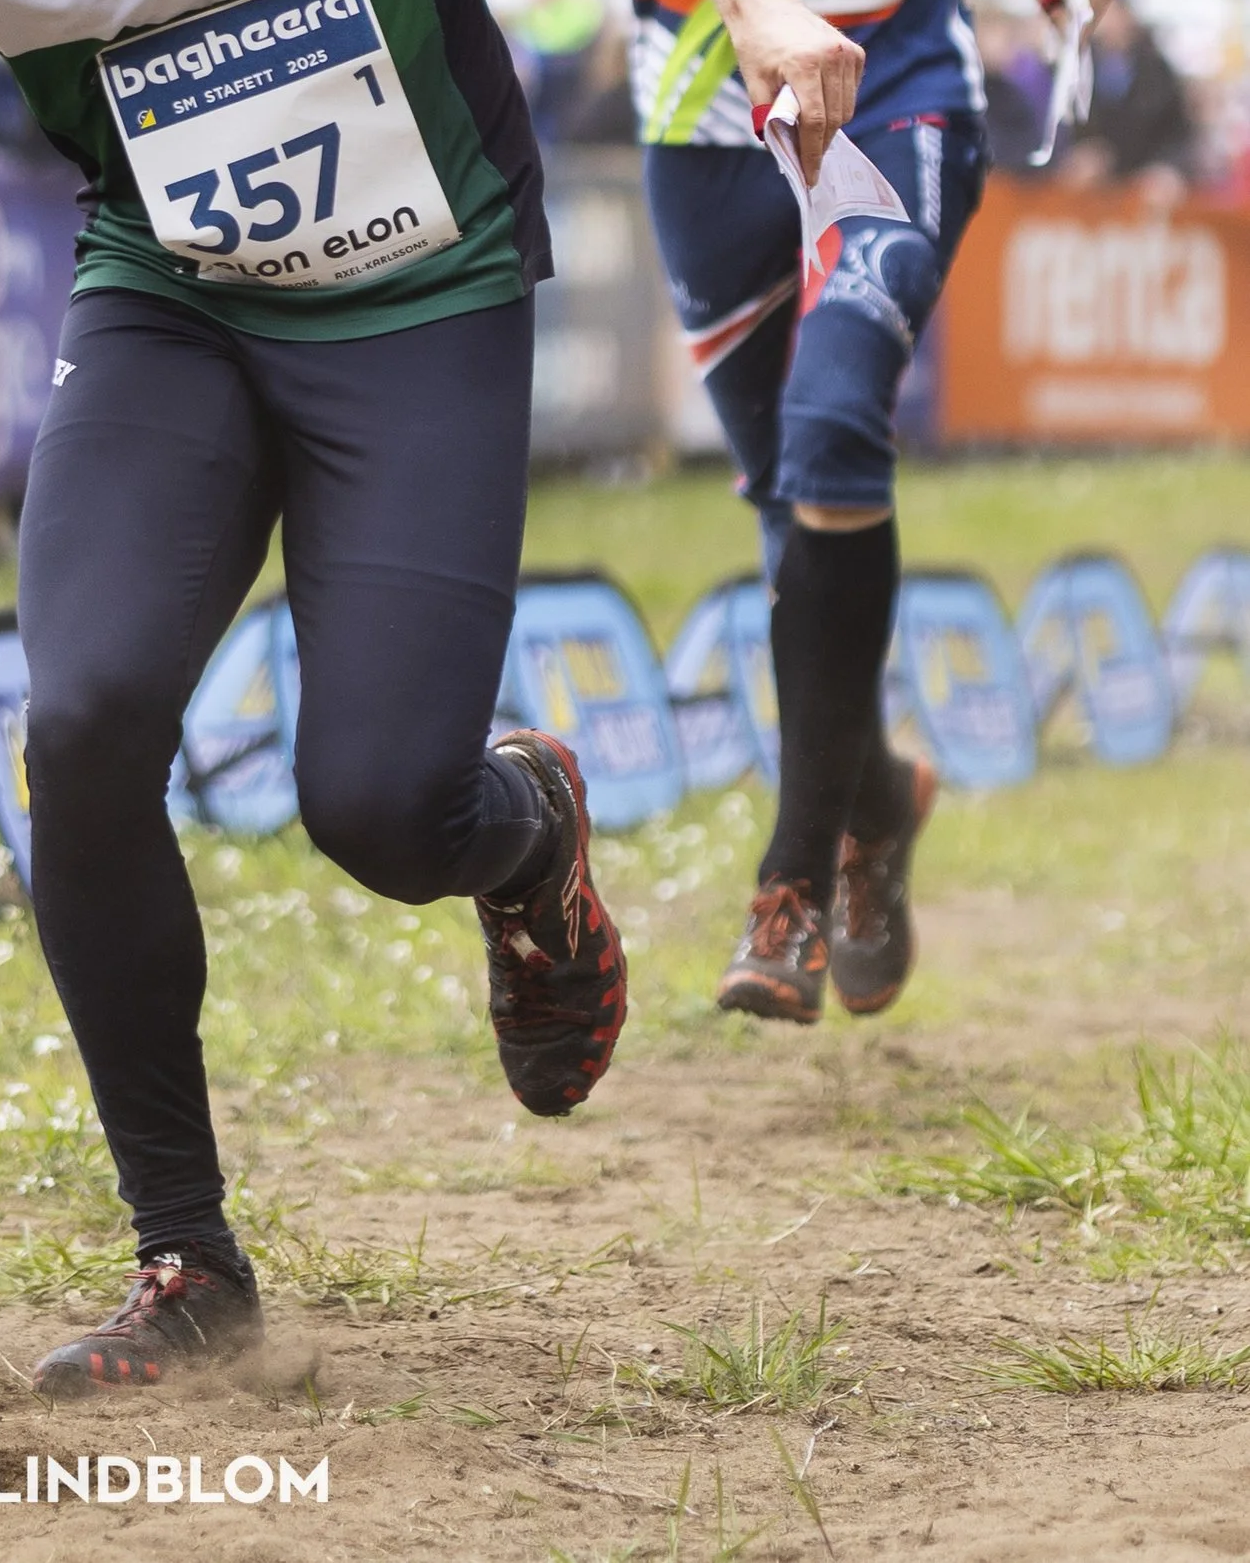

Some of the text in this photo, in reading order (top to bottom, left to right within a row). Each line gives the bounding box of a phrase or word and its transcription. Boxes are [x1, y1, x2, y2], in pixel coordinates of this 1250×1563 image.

[173, 50, 328, 115] SM STAFETT 2025
[353, 64, 386, 107] 1
[164, 121, 341, 256] 357
[334, 239, 429, 281] AXEL-KARLSSONS
